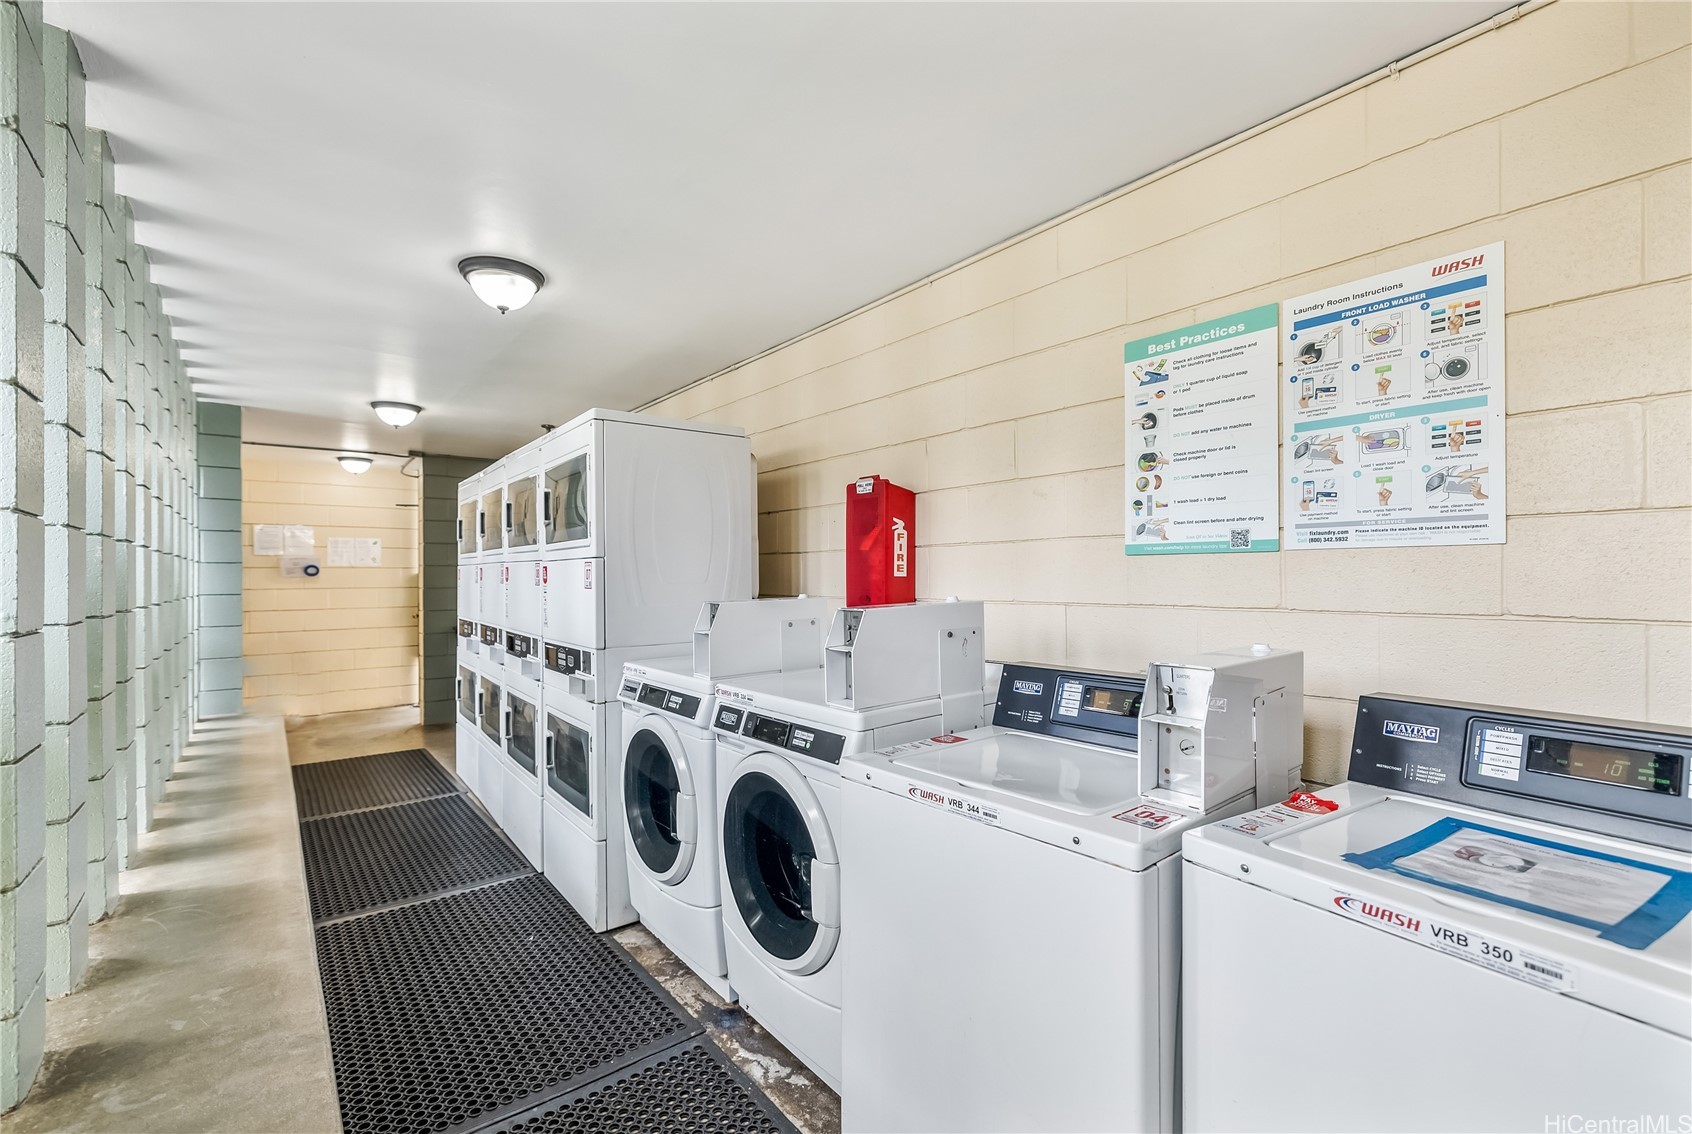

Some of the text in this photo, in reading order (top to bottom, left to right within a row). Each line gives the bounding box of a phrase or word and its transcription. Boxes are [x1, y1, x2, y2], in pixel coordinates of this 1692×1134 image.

[1432, 254, 1484, 277] WASH
[1294, 283, 1403, 315] Laundry Room Instructions
[1342, 292, 1426, 318] FRONT LOAD WASHER
[1148, 323, 1245, 354] Best Practices
[1216, 351, 1244, 360] instructions
[1369, 411, 1395, 420] DRYER
[1015, 681, 1041, 690] MAYTAG
[1387, 722, 1436, 737] MAYTAG
[1604, 763, 1622, 776] 10
[920, 788, 944, 804] WASH
[948, 797, 963, 809] VRB
[967, 803, 980, 814] 344
[1300, 794, 1317, 804] PAY
[1134, 811, 1170, 823] 04
[1361, 902, 1420, 932] WASH
[1430, 924, 1469, 947] VRB
[1481, 942, 1513, 962] 350
